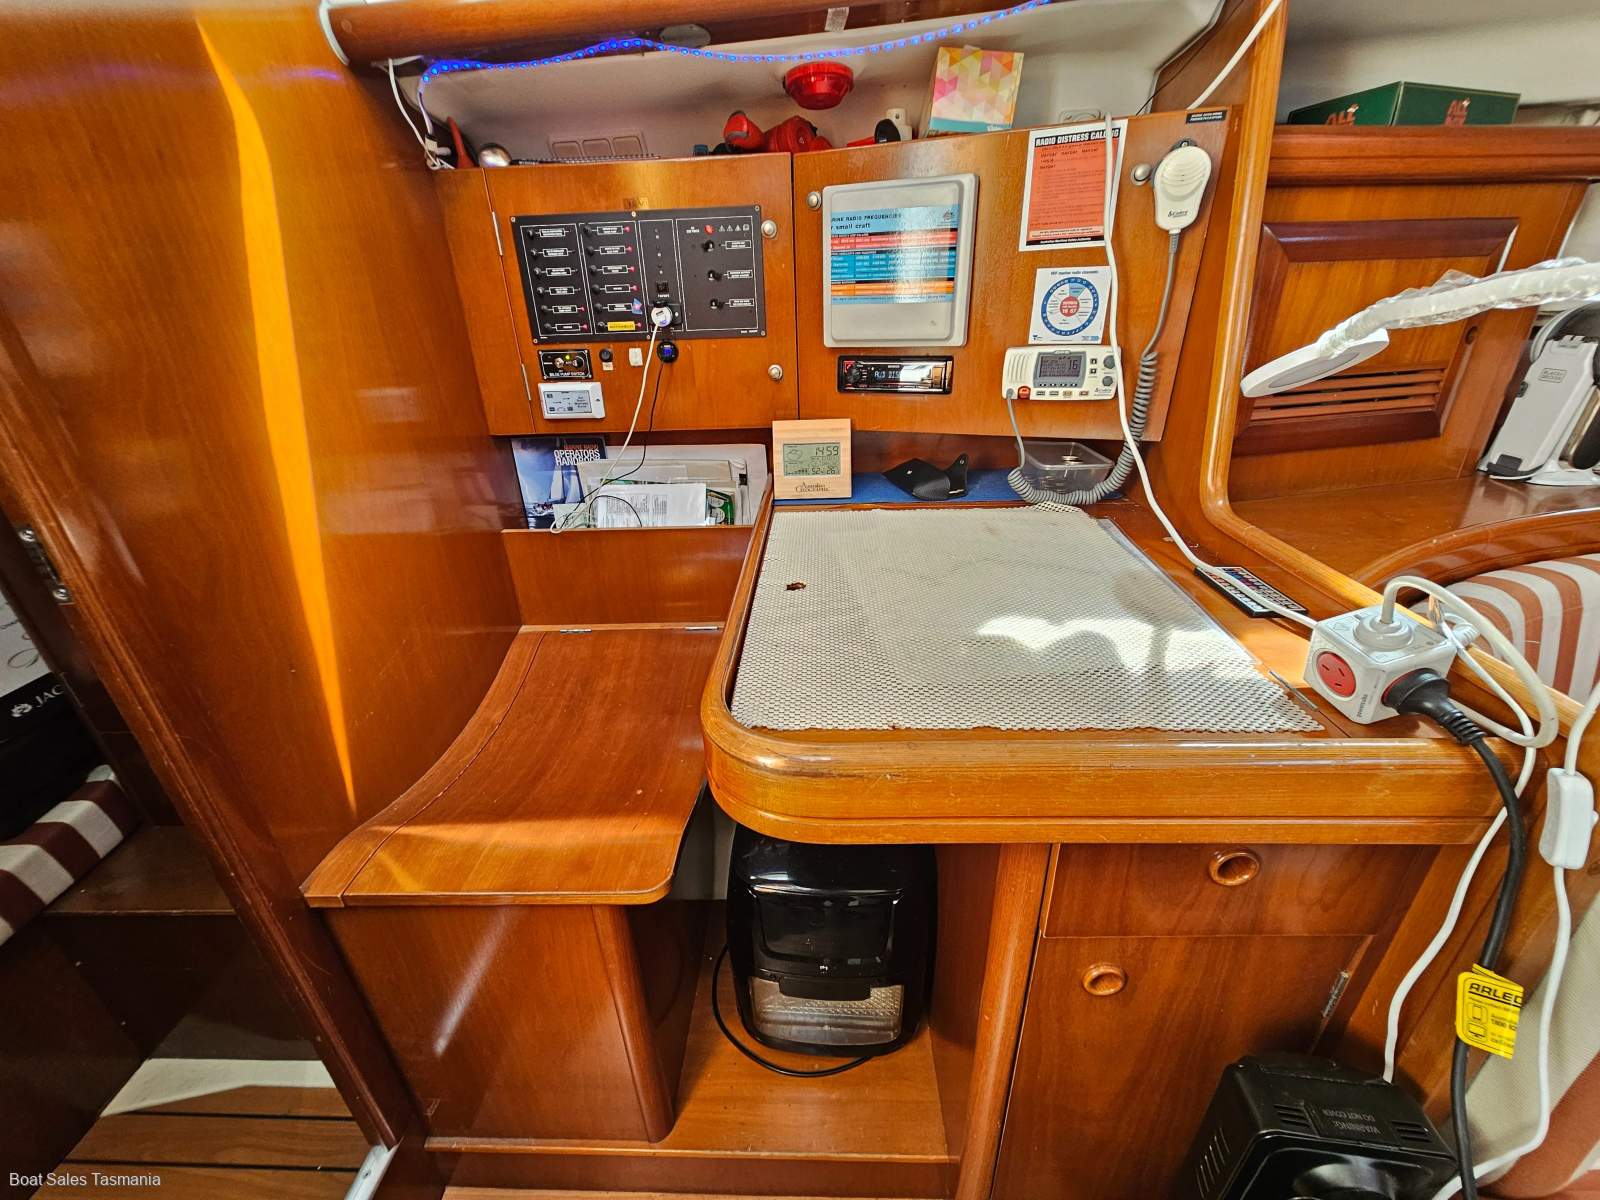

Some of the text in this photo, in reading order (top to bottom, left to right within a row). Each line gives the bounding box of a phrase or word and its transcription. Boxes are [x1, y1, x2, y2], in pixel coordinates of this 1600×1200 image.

[1035, 137, 1056, 147] RADIO
[1057, 132, 1089, 144] DISTRESS
[553, 449, 601, 458] OPERATORS
